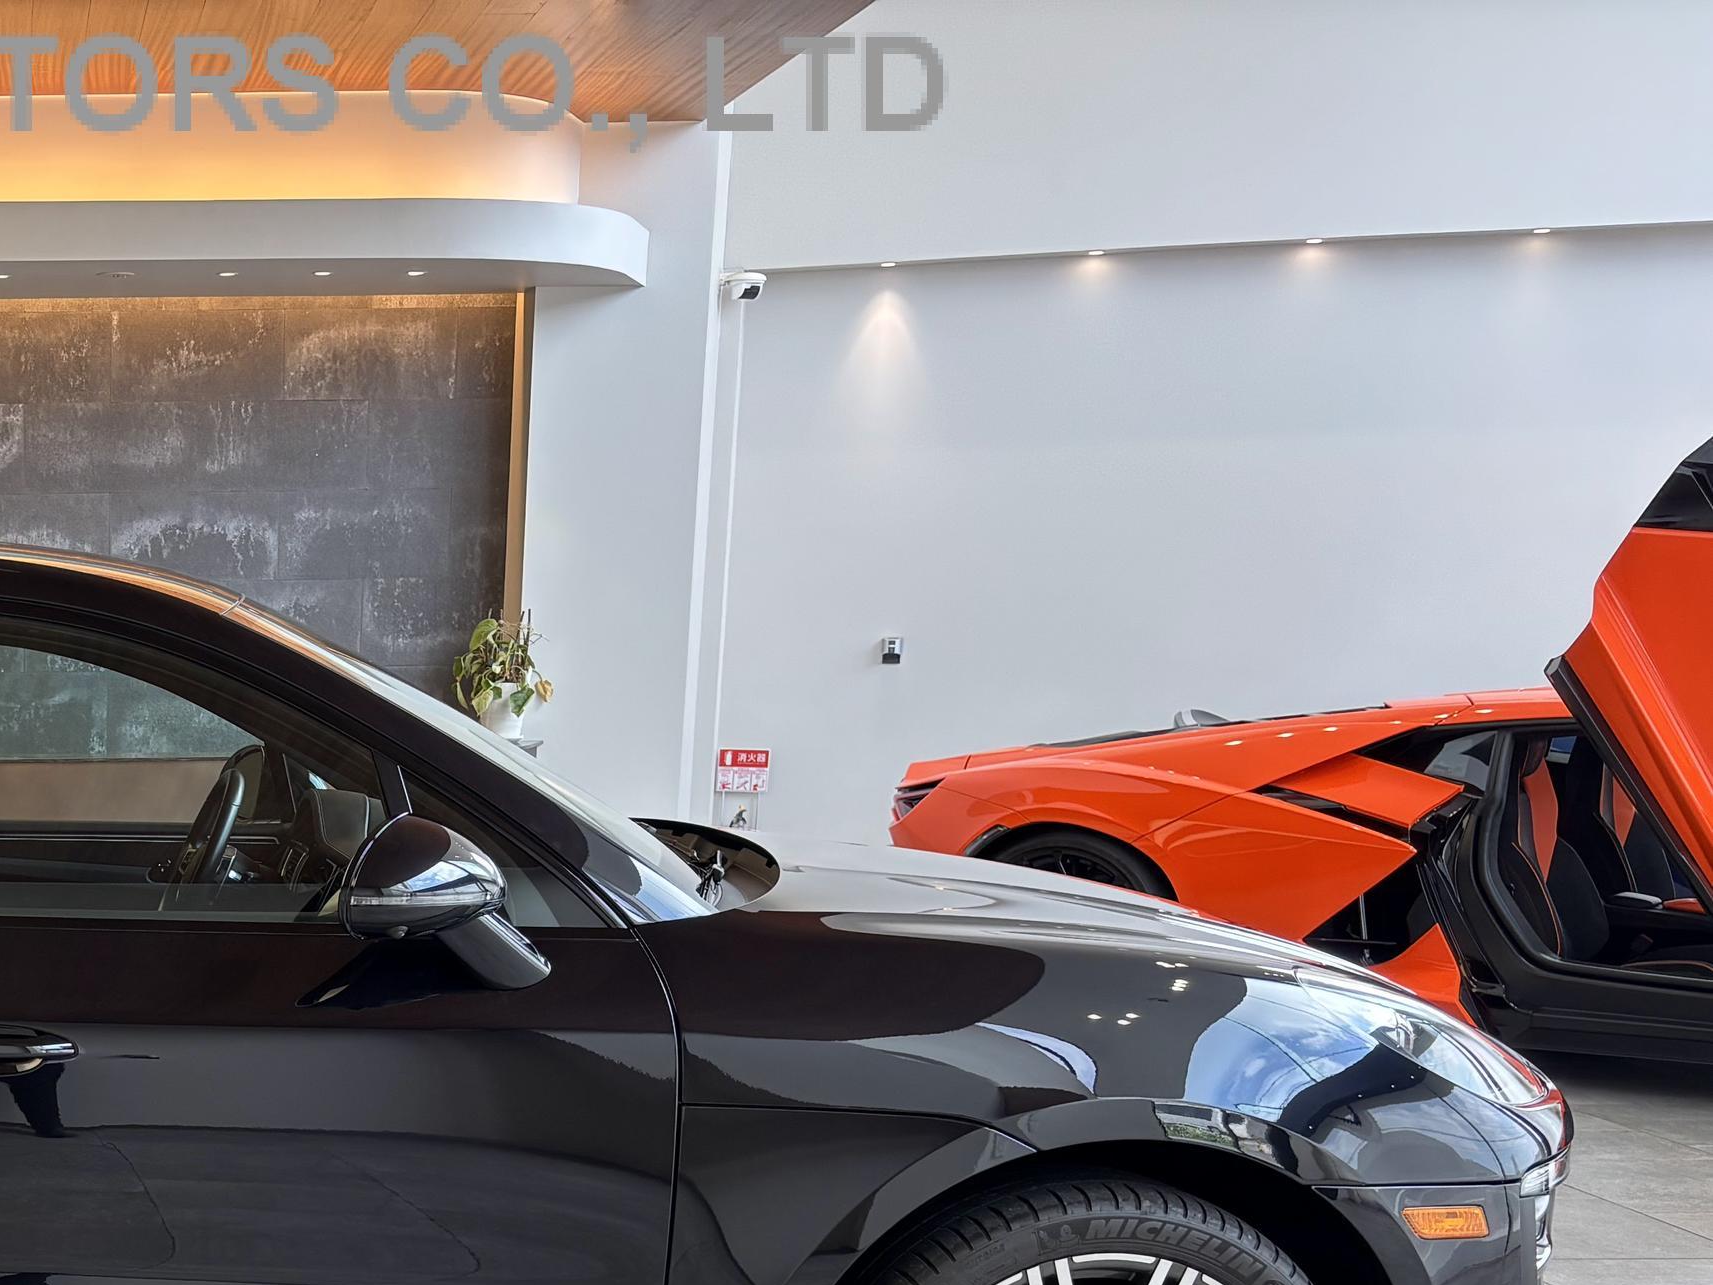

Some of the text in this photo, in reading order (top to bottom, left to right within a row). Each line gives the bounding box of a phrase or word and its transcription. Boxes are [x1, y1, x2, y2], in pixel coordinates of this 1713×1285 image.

[737, 752, 766, 762] 消火器
[1088, 1218, 1267, 1285] MICHELIN
